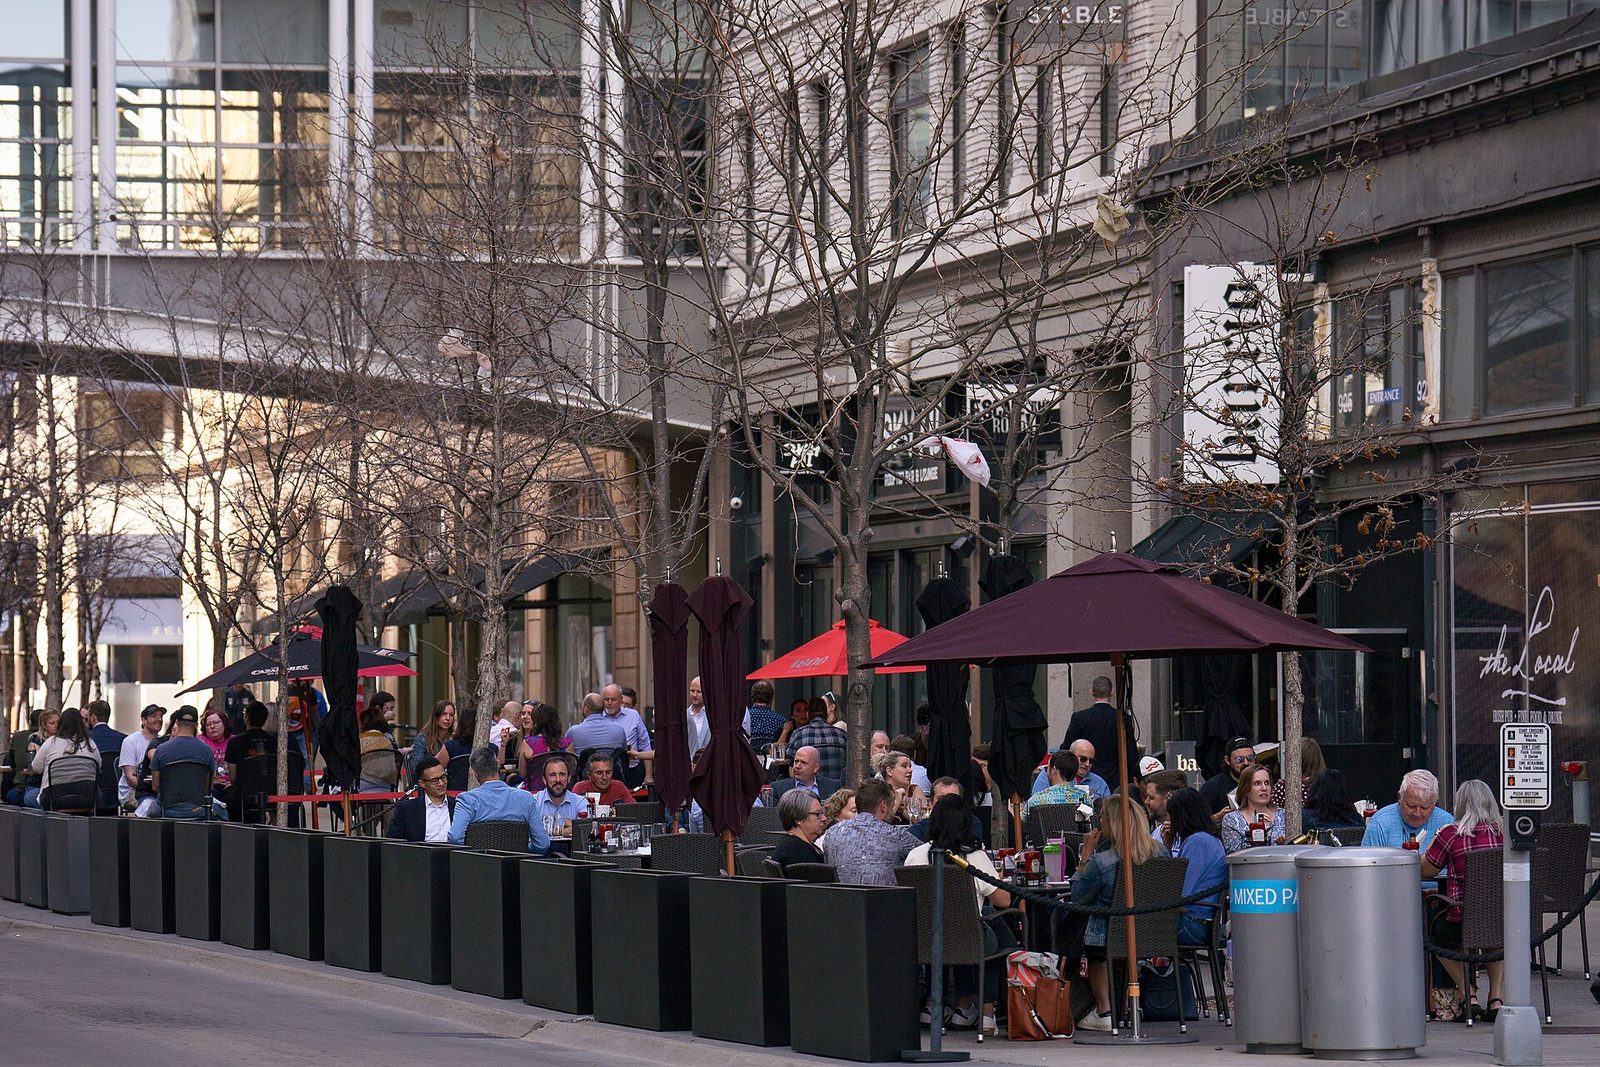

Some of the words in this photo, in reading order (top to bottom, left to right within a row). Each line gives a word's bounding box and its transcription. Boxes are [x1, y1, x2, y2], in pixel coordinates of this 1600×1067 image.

[1369, 388, 1400, 404] ENTRANCE
[1479, 623, 1512, 680] the
[1511, 585, 1580, 682] Local
[1176, 754, 1201, 771] ba
[1234, 888, 1277, 905] MIXED
